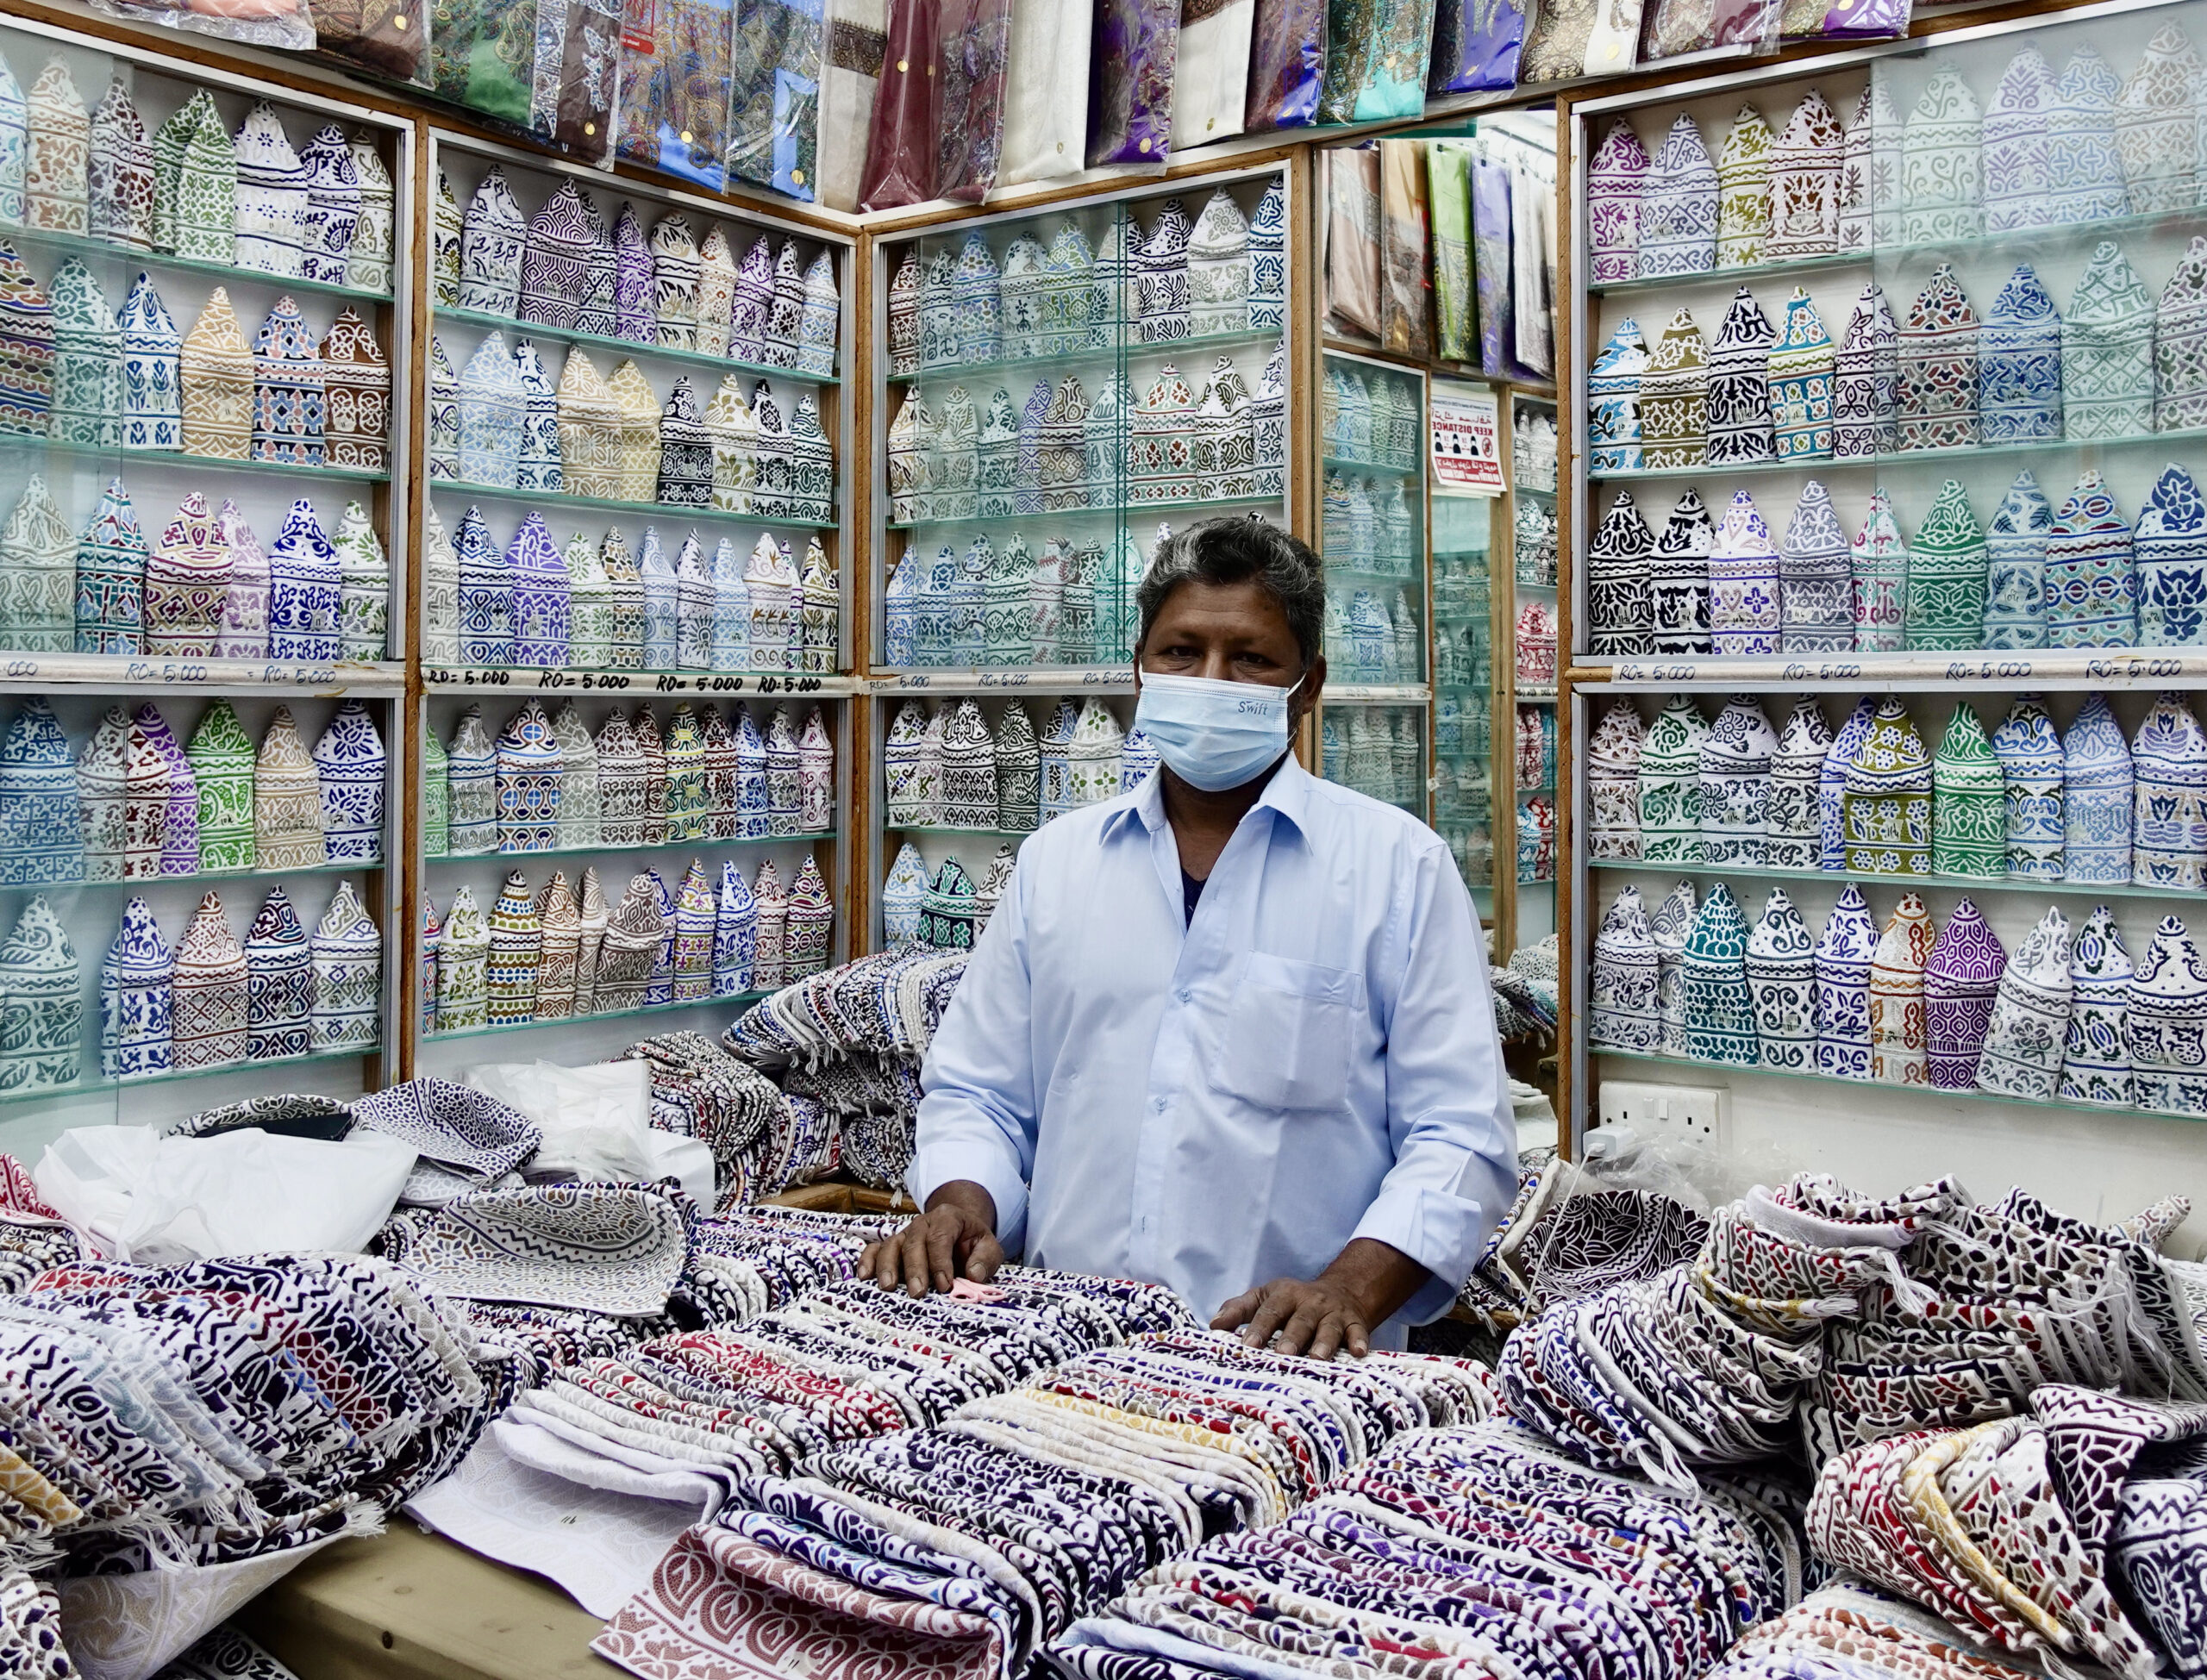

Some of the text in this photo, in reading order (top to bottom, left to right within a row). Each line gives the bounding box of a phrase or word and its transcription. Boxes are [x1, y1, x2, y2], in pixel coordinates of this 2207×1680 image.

[0, 661, 38, 677] .000
[163, 665, 207, 683] 5.000
[1653, 665, 1696, 680] 5.000
[1820, 664, 1860, 679] 5.000
[1981, 662, 2031, 678] 5.000
[2128, 659, 2182, 677] 5.000
[296, 669, 336, 684] 5.000
[465, 671, 510, 686] 5.000
[582, 673, 629, 689] 5.000
[696, 678, 743, 690] 5.000
[784, 678, 822, 692] 5.000
[1238, 701, 1268, 715] Swift
